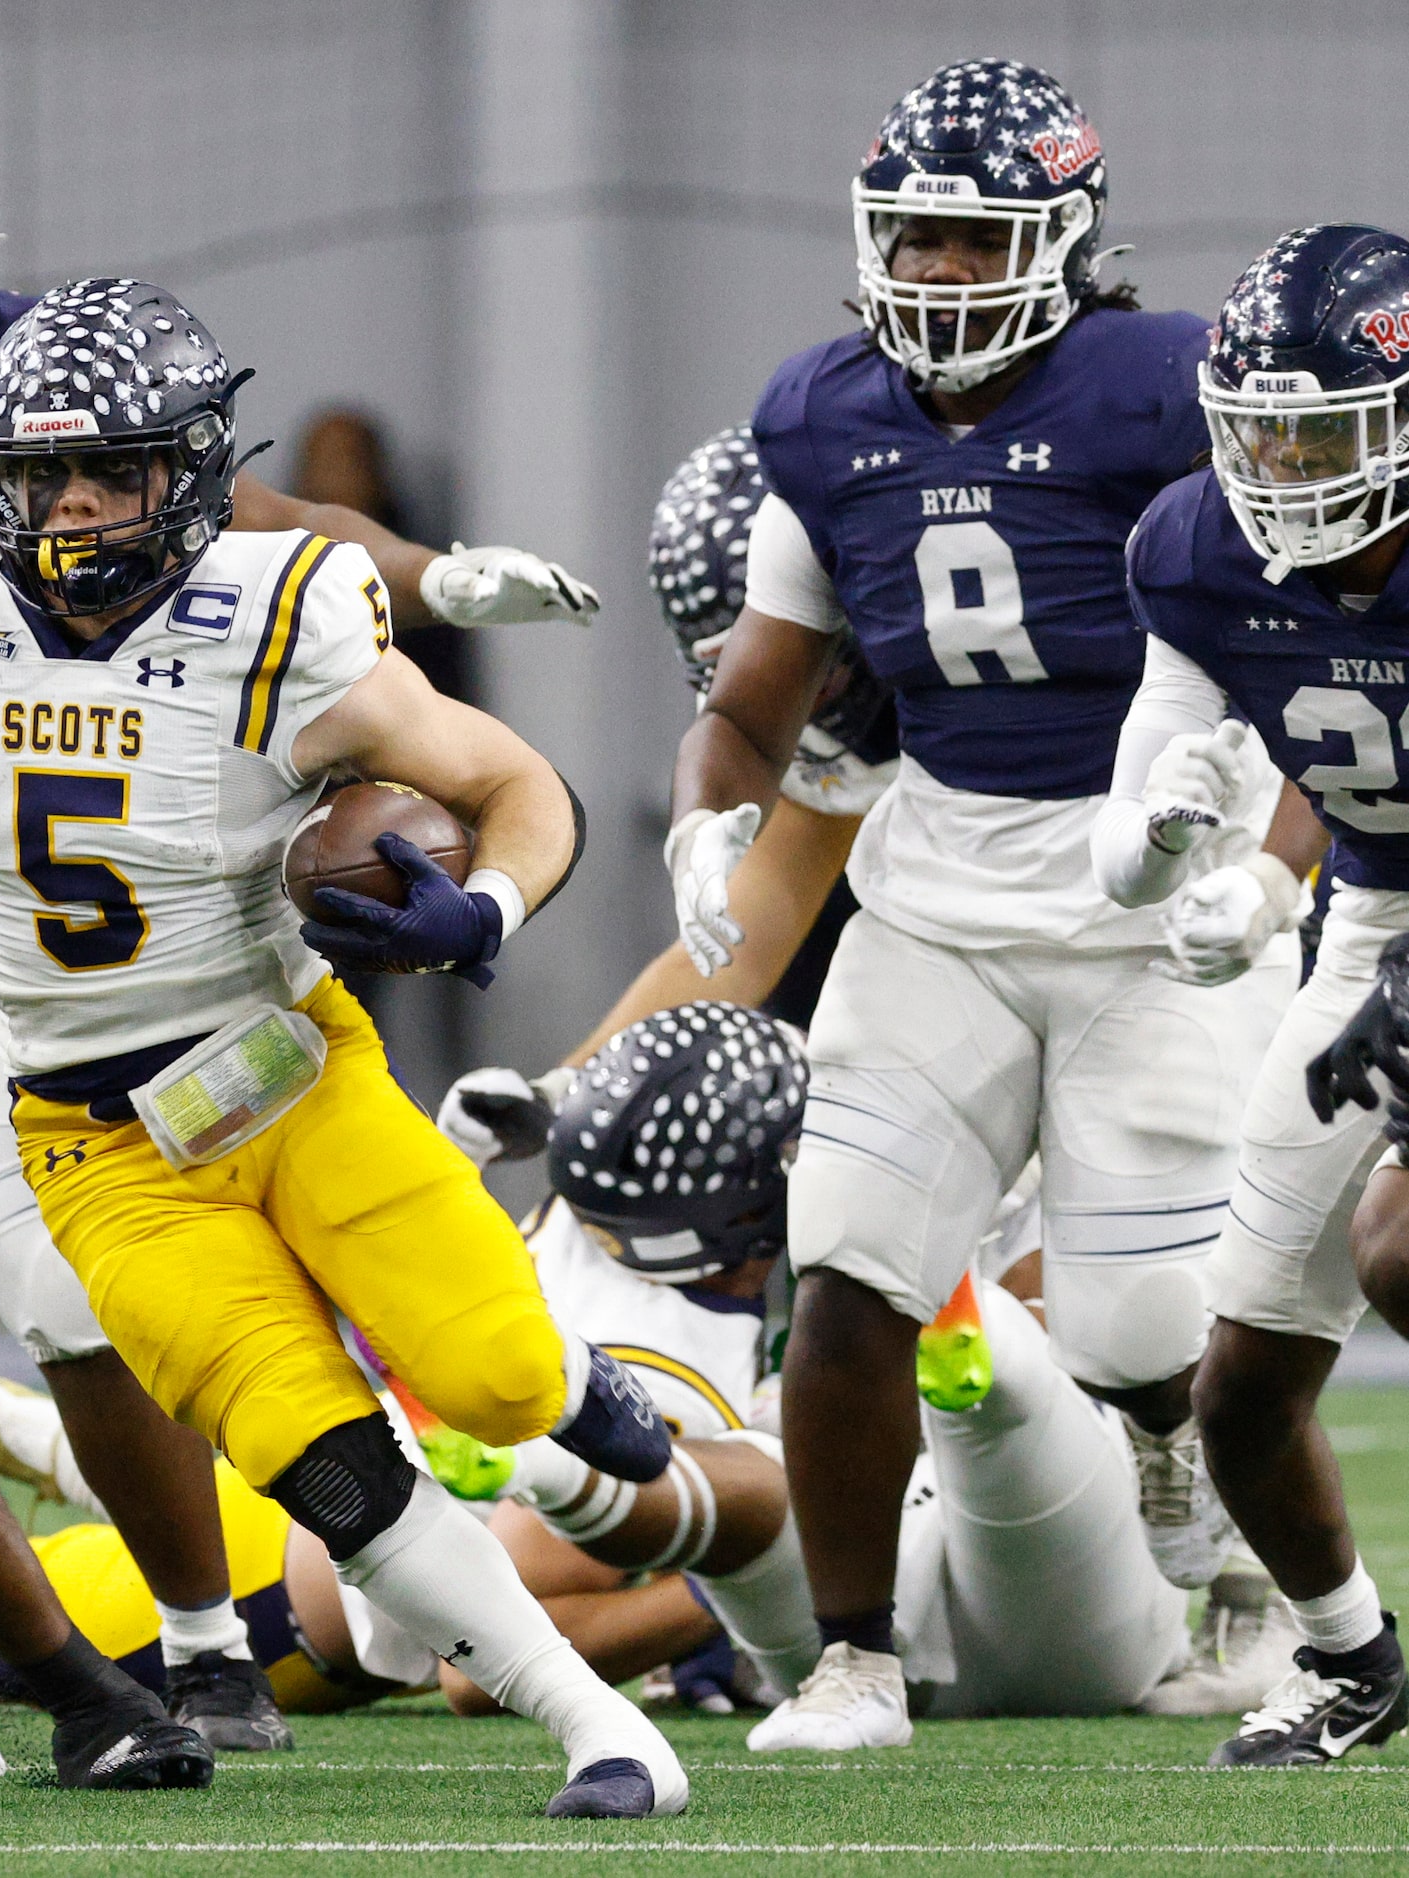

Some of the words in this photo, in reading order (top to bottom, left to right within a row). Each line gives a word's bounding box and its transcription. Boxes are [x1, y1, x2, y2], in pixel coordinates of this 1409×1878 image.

[916, 180, 960, 194] BLUE
[1255, 378, 1299, 393] BLUE
[921, 487, 992, 516] RYAN
[172, 589, 237, 630] C
[358, 574, 390, 656] 5
[1329, 657, 1406, 684] RYAN
[1, 699, 144, 760] SCOTS
[1282, 685, 1409, 834] 2
[13, 766, 152, 973] 5
